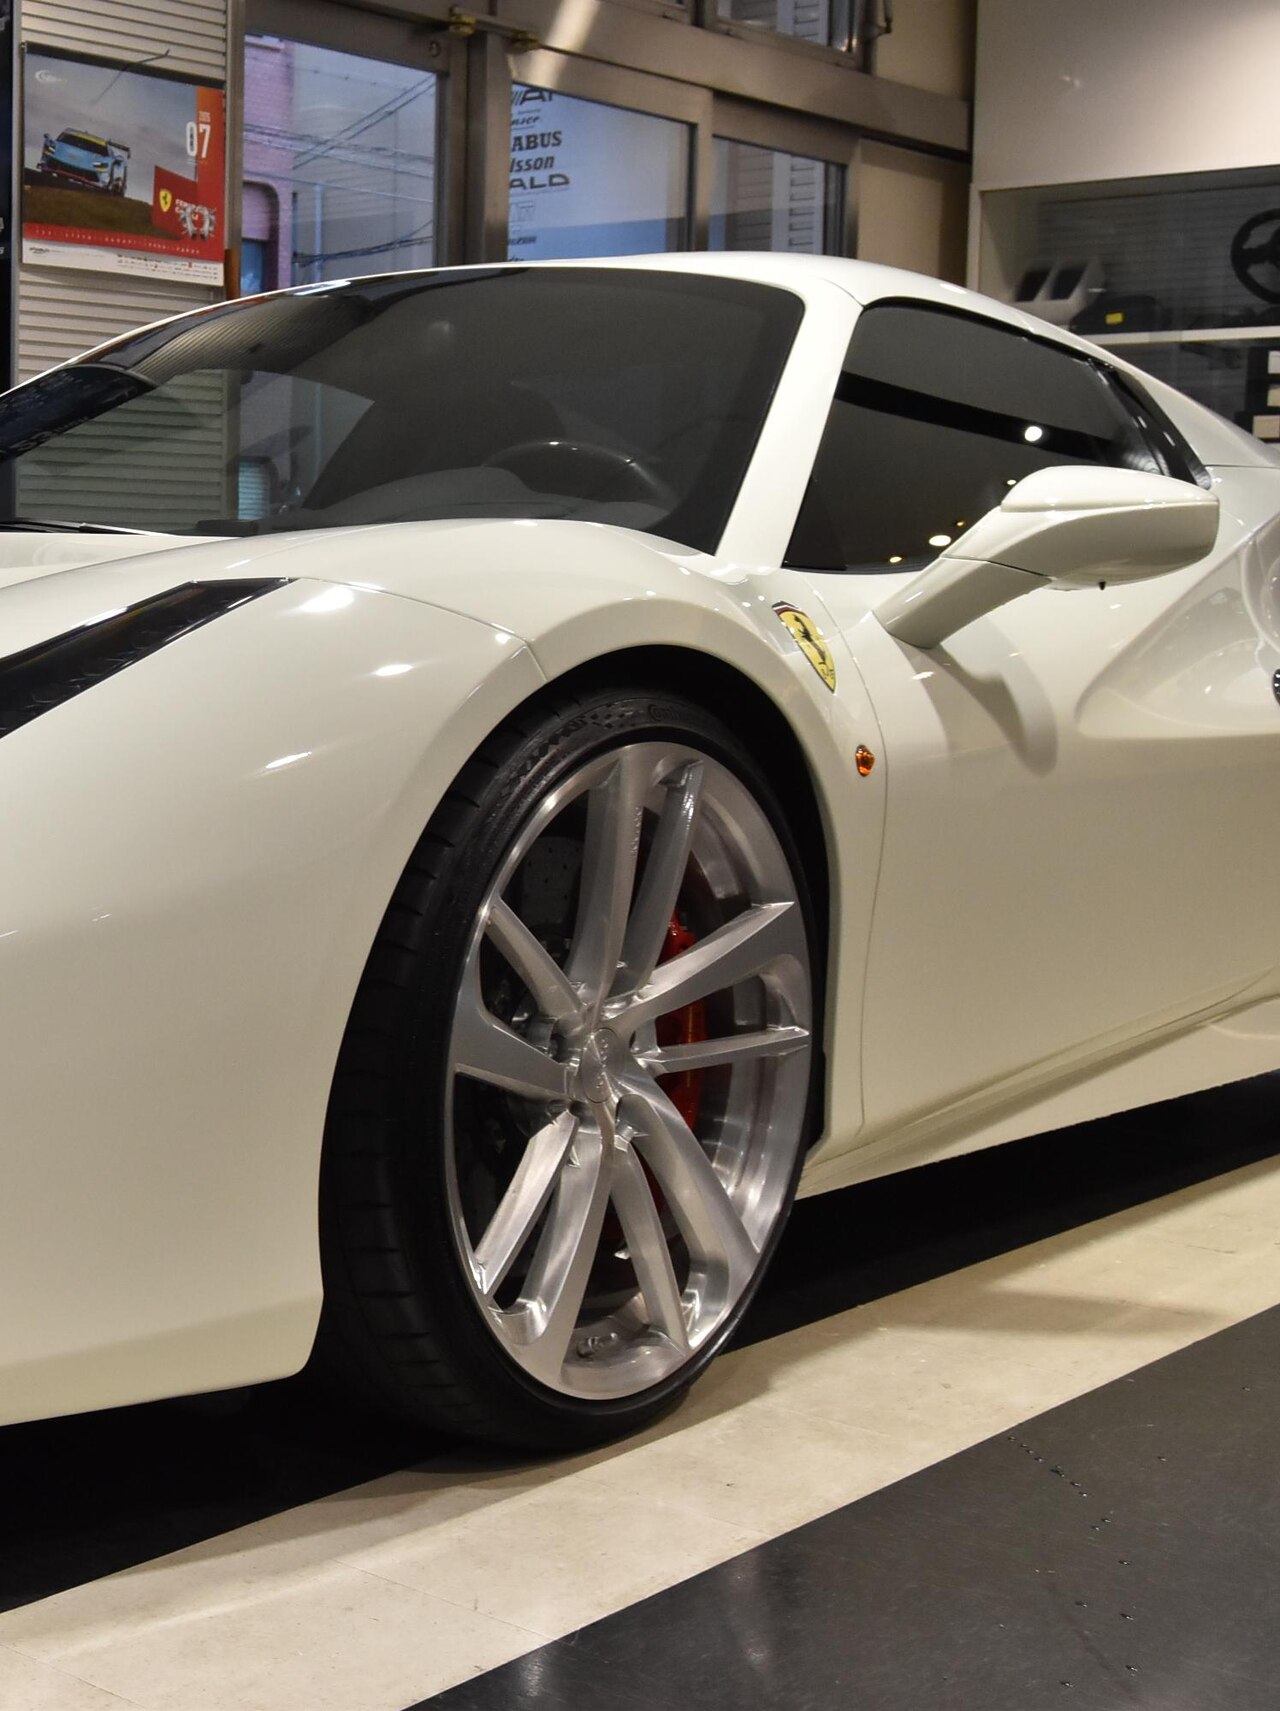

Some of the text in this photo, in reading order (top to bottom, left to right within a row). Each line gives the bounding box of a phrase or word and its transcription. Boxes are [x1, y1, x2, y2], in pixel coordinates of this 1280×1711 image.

[186, 121, 211, 158] 07
[511, 131, 562, 152] ABUS
[509, 173, 570, 190] ALD
